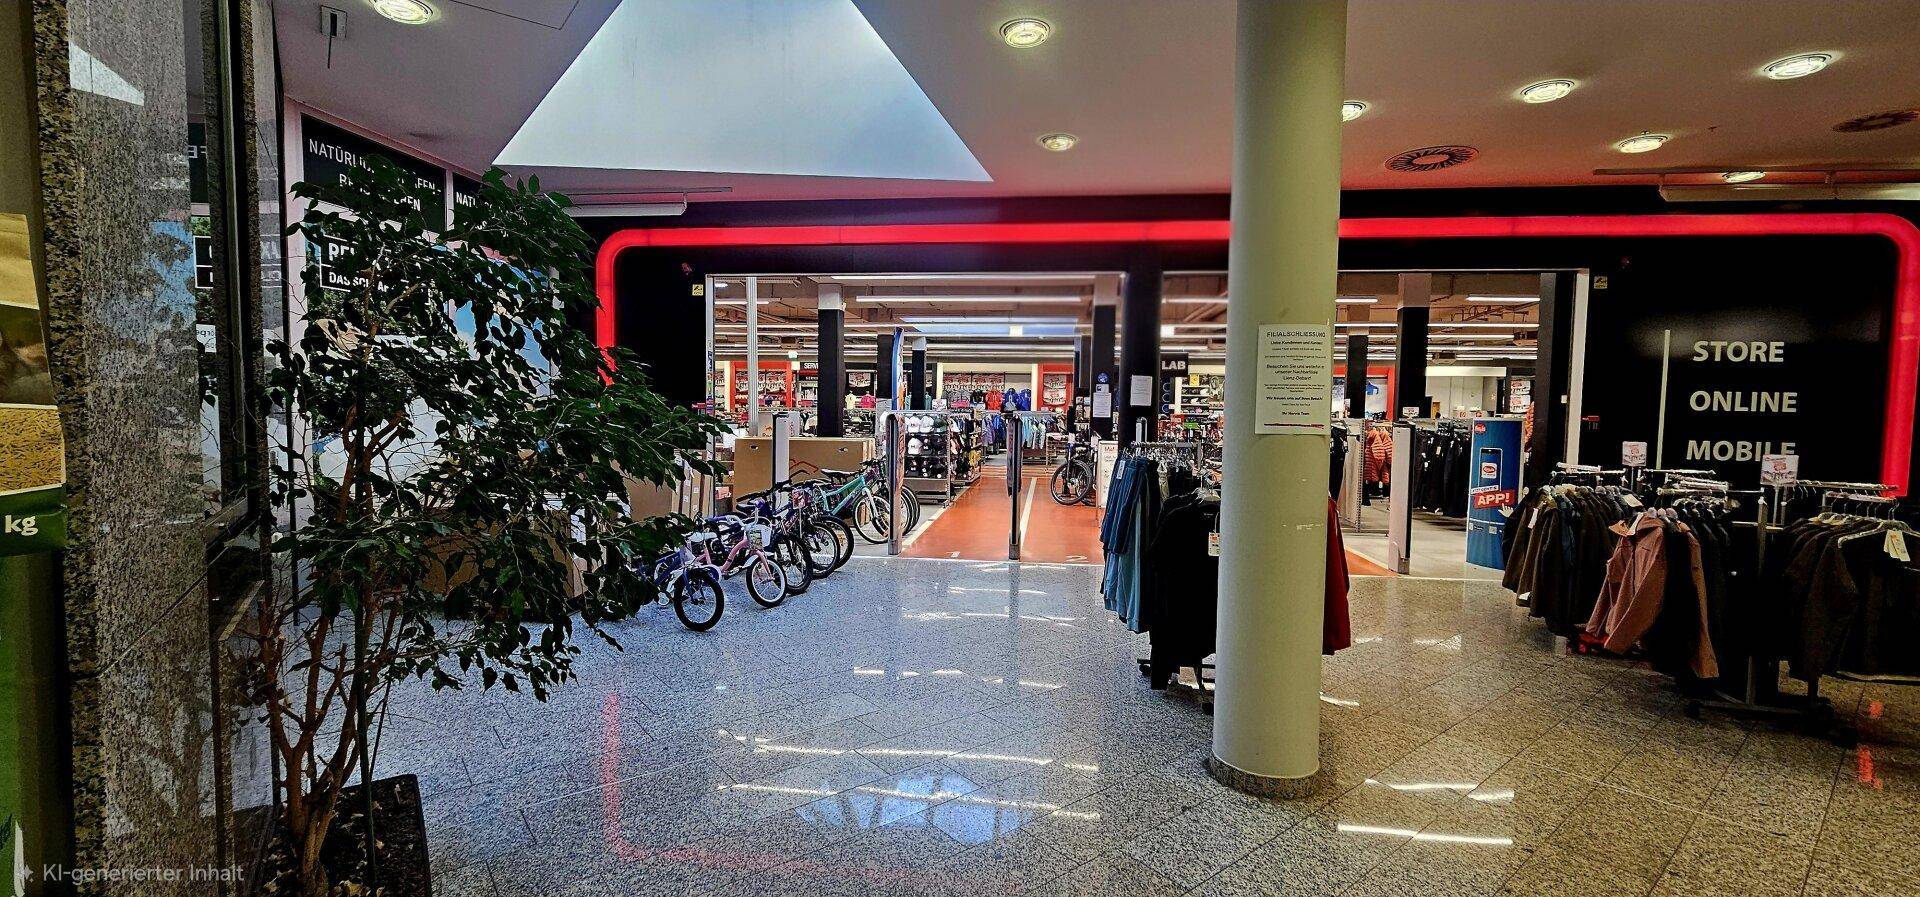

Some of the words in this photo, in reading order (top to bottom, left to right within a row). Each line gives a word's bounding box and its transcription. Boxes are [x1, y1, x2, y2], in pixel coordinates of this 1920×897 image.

[329, 271, 350, 286] DAS
[1693, 340, 1785, 363] STORE
[1161, 360, 1186, 370] LAB
[1689, 390, 1798, 413] ONLINE
[1686, 440, 1796, 462] MOBILE
[1477, 492, 1511, 506] APP!
[4, 514, 39, 537] kg
